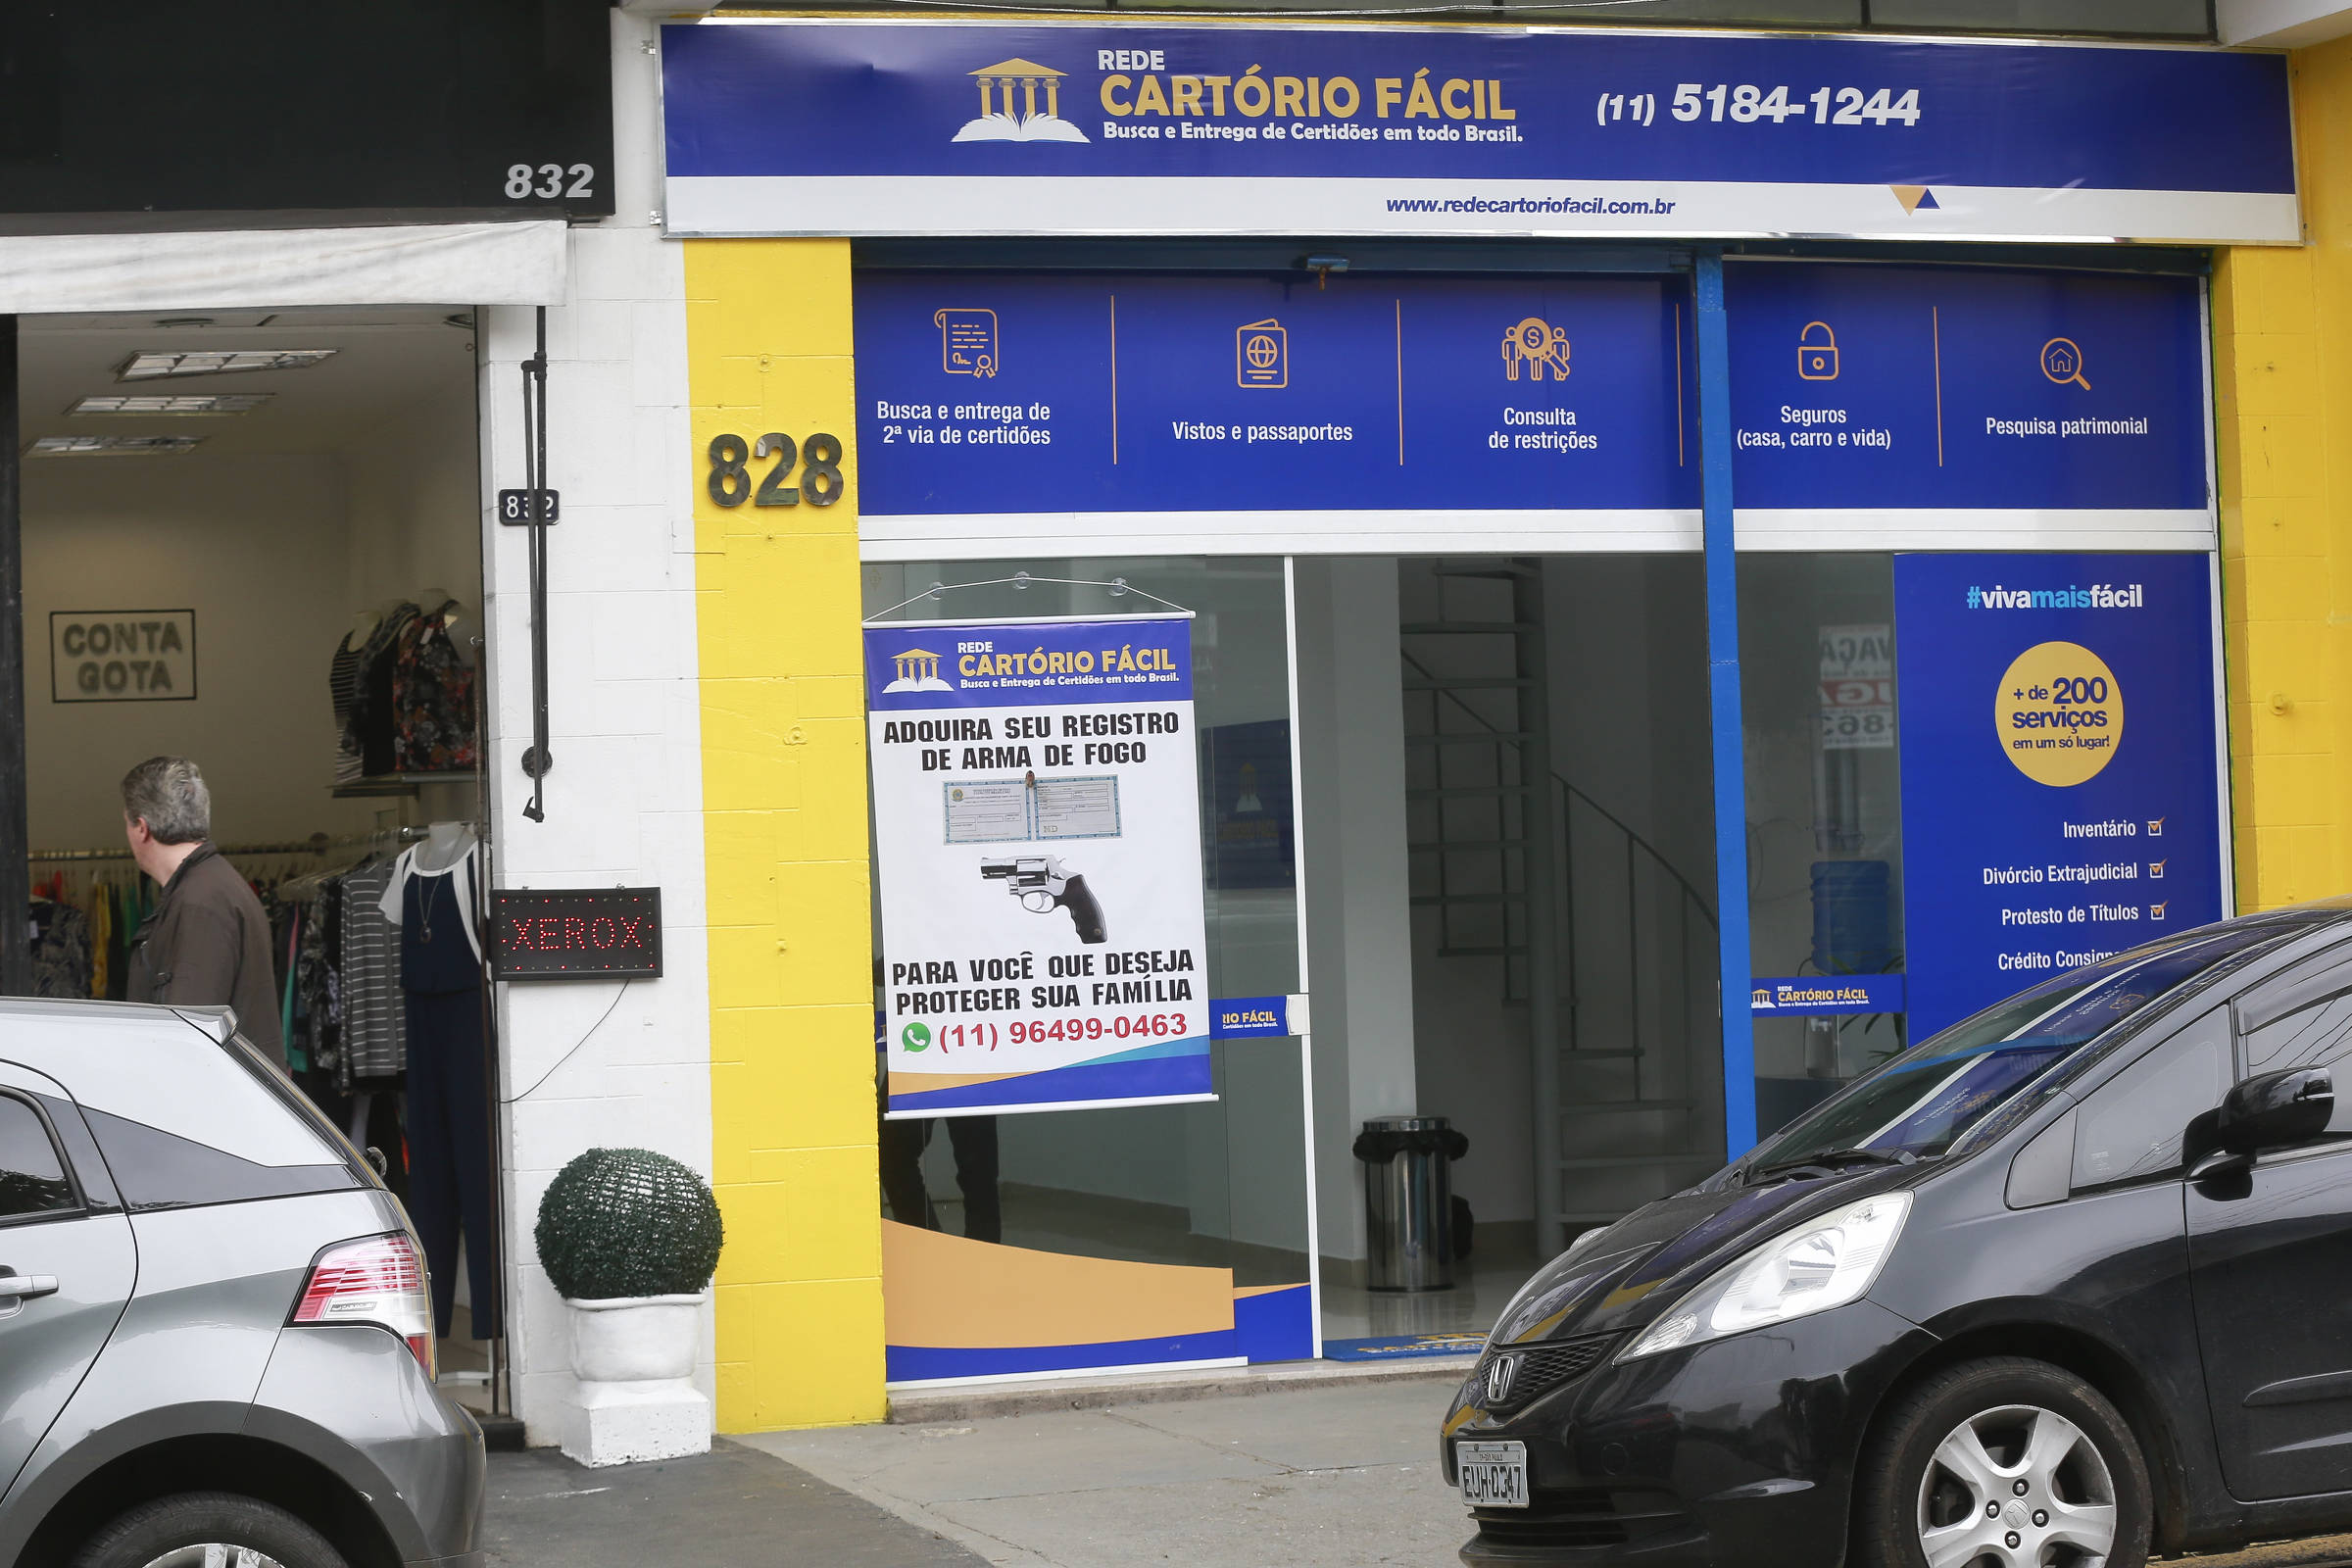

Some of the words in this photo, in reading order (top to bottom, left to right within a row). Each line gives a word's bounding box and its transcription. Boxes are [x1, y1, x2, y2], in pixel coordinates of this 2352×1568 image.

[1098, 50, 1165, 71] REDE
[1100, 64, 1360, 118] CARTÓRIO
[1375, 67, 1516, 120] FÁCIL
[1596, 93, 1654, 126] (11)
[1671, 83, 1921, 126] 5184-1244
[1103, 122, 1159, 139] Busca
[1165, 125, 1176, 139] e
[1181, 122, 1257, 141] Entrega
[1262, 122, 1286, 139] de
[1291, 123, 1378, 141] Certidões
[1384, 127, 1412, 141] em
[1417, 124, 1460, 141] todo
[1465, 125, 1523, 142] Brasil.
[505, 164, 595, 198] 832
[1386, 196, 1677, 215] www.redecartoriofacil.com.br
[877, 401, 932, 419] Busca
[938, 405, 949, 419] e
[955, 402, 1023, 423] entrega
[1029, 402, 1051, 420] de
[1503, 408, 1576, 426] Consulta
[1781, 406, 1846, 427] Seguros
[907, 425, 935, 444] via
[940, 425, 961, 444] de
[967, 425, 1051, 445] certidões
[1173, 421, 1225, 440] Vistos
[1232, 426, 1242, 440] e
[1248, 422, 1353, 445] passaportes
[1737, 428, 1785, 450] (casa,
[1790, 431, 1832, 447] carro
[1838, 432, 1847, 447] e
[1851, 427, 1891, 450] vida)
[1985, 417, 2057, 437] Pesquisa
[2062, 417, 2147, 437] patrimonial
[1488, 430, 1509, 449] de
[1515, 431, 1597, 453] restrições
[709, 432, 845, 508] 828
[1967, 584, 2143, 609] #vivamaisfácil
[63, 621, 183, 657] CONTA
[957, 641, 994, 654] REDE
[958, 647, 1095, 677] CARTÓRIO
[1102, 644, 1176, 672] FÁCIL
[77, 660, 173, 695] GOTA
[960, 679, 990, 689] Busca
[1001, 677, 1040, 688] Entrega
[1043, 676, 1056, 686] de
[1058, 674, 1103, 686] Certidões
[1124, 673, 1148, 683] todo
[1149, 671, 1180, 683] Brasil.
[2028, 684, 2049, 700] de
[2052, 676, 2108, 705] 200
[883, 718, 993, 744] ADQUIRA
[1004, 715, 1052, 740] SEU
[1061, 711, 1179, 738] REGISTRO
[2012, 706, 2108, 734] serviços
[2013, 739, 2034, 750] em
[2036, 738, 2056, 749] um
[2059, 735, 2074, 749] só
[2076, 734, 2110, 751] lugar!
[921, 748, 952, 771] DE
[961, 746, 1032, 769] ARMA
[1045, 744, 1074, 767] DE
[1085, 741, 1147, 765] FOGO
[2063, 820, 2136, 839] Inventário
[1983, 865, 2043, 885] Divórcio
[2047, 862, 2137, 885] Extrajudicial
[2001, 908, 2062, 926] Protesto
[2067, 906, 2085, 923] de
[2090, 904, 2139, 922] Títulos
[512, 917, 642, 951] XEROX
[892, 960, 957, 986] PARA
[968, 951, 1034, 982] VOCÊ
[1048, 954, 1095, 979] QUE
[1104, 949, 1195, 975] DESEJA
[1998, 952, 2050, 970] Crédito
[896, 988, 1021, 1016] PROTEGER
[1031, 984, 1081, 1009] SUA
[1092, 974, 1193, 1006] FAMÍLIA
[1778, 988, 1835, 1002] CARTÓRIO
[1837, 987, 1868, 1000] FÁCIL
[1242, 1009, 1277, 1023] FÁCIL
[940, 1022, 999, 1054] (11)
[1009, 1012, 1189, 1046] 96499-0463
